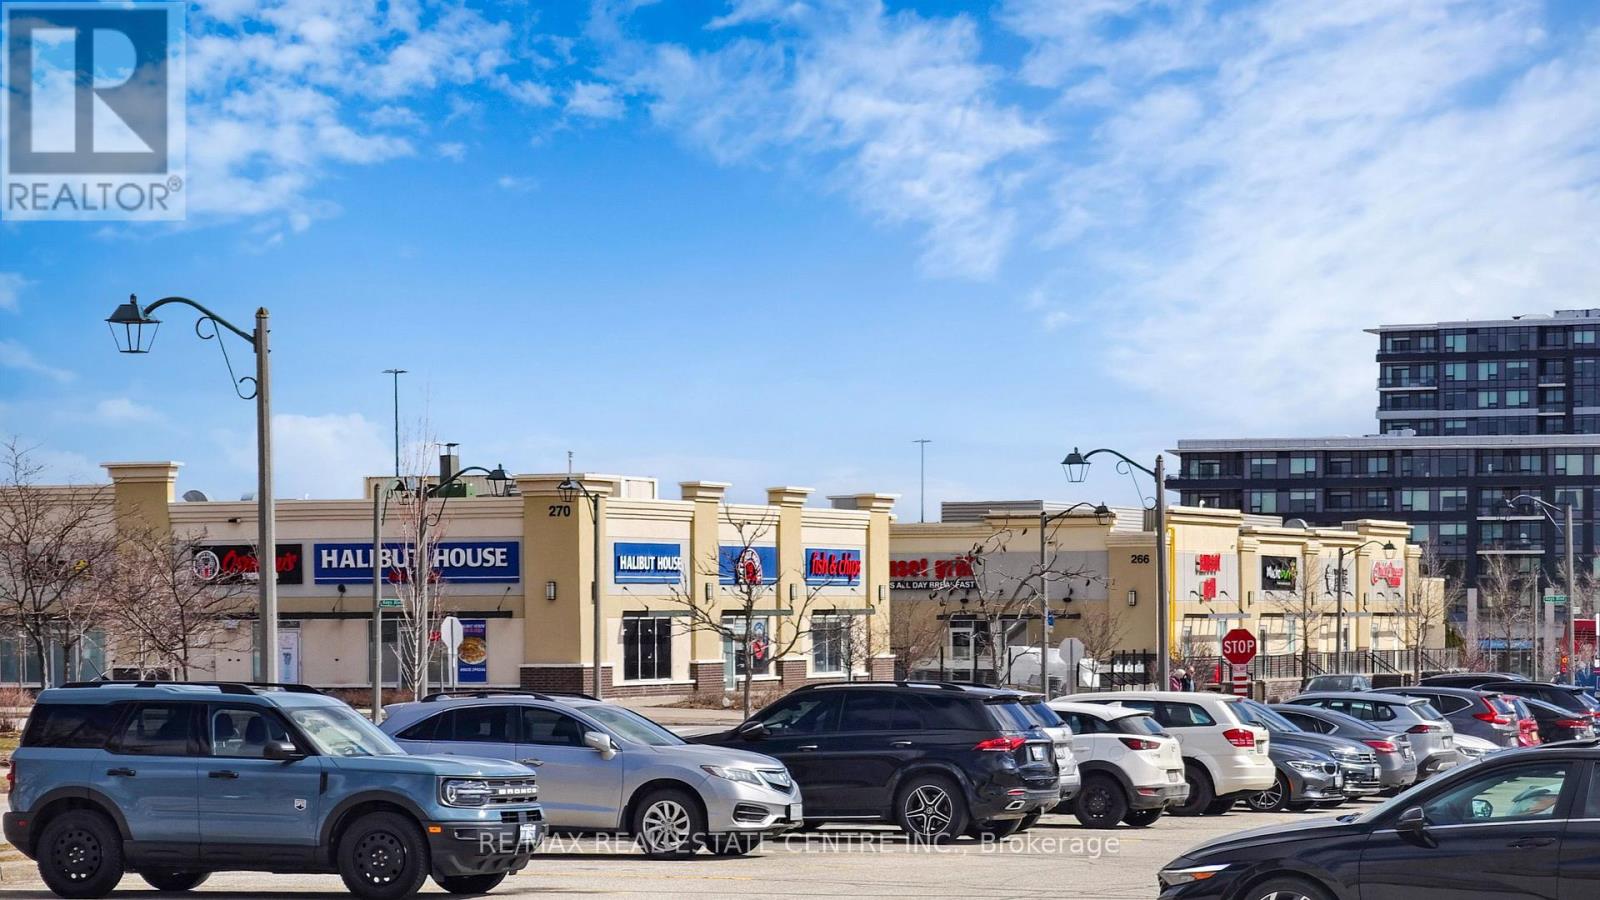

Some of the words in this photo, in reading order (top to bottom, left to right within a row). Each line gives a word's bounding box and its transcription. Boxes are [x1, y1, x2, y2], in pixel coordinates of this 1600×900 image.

[548, 505, 571, 517] 270
[321, 548, 419, 569] HALIBU
[433, 547, 508, 567] HOUSE
[620, 555, 656, 570] HALIBUT
[657, 556, 683, 570] HOUSE
[1131, 554, 1150, 564] 266
[896, 581, 911, 589] ALL
[912, 581, 928, 589] DAY
[929, 581, 975, 589] BREAFAST
[1223, 640, 1255, 654] STOP
